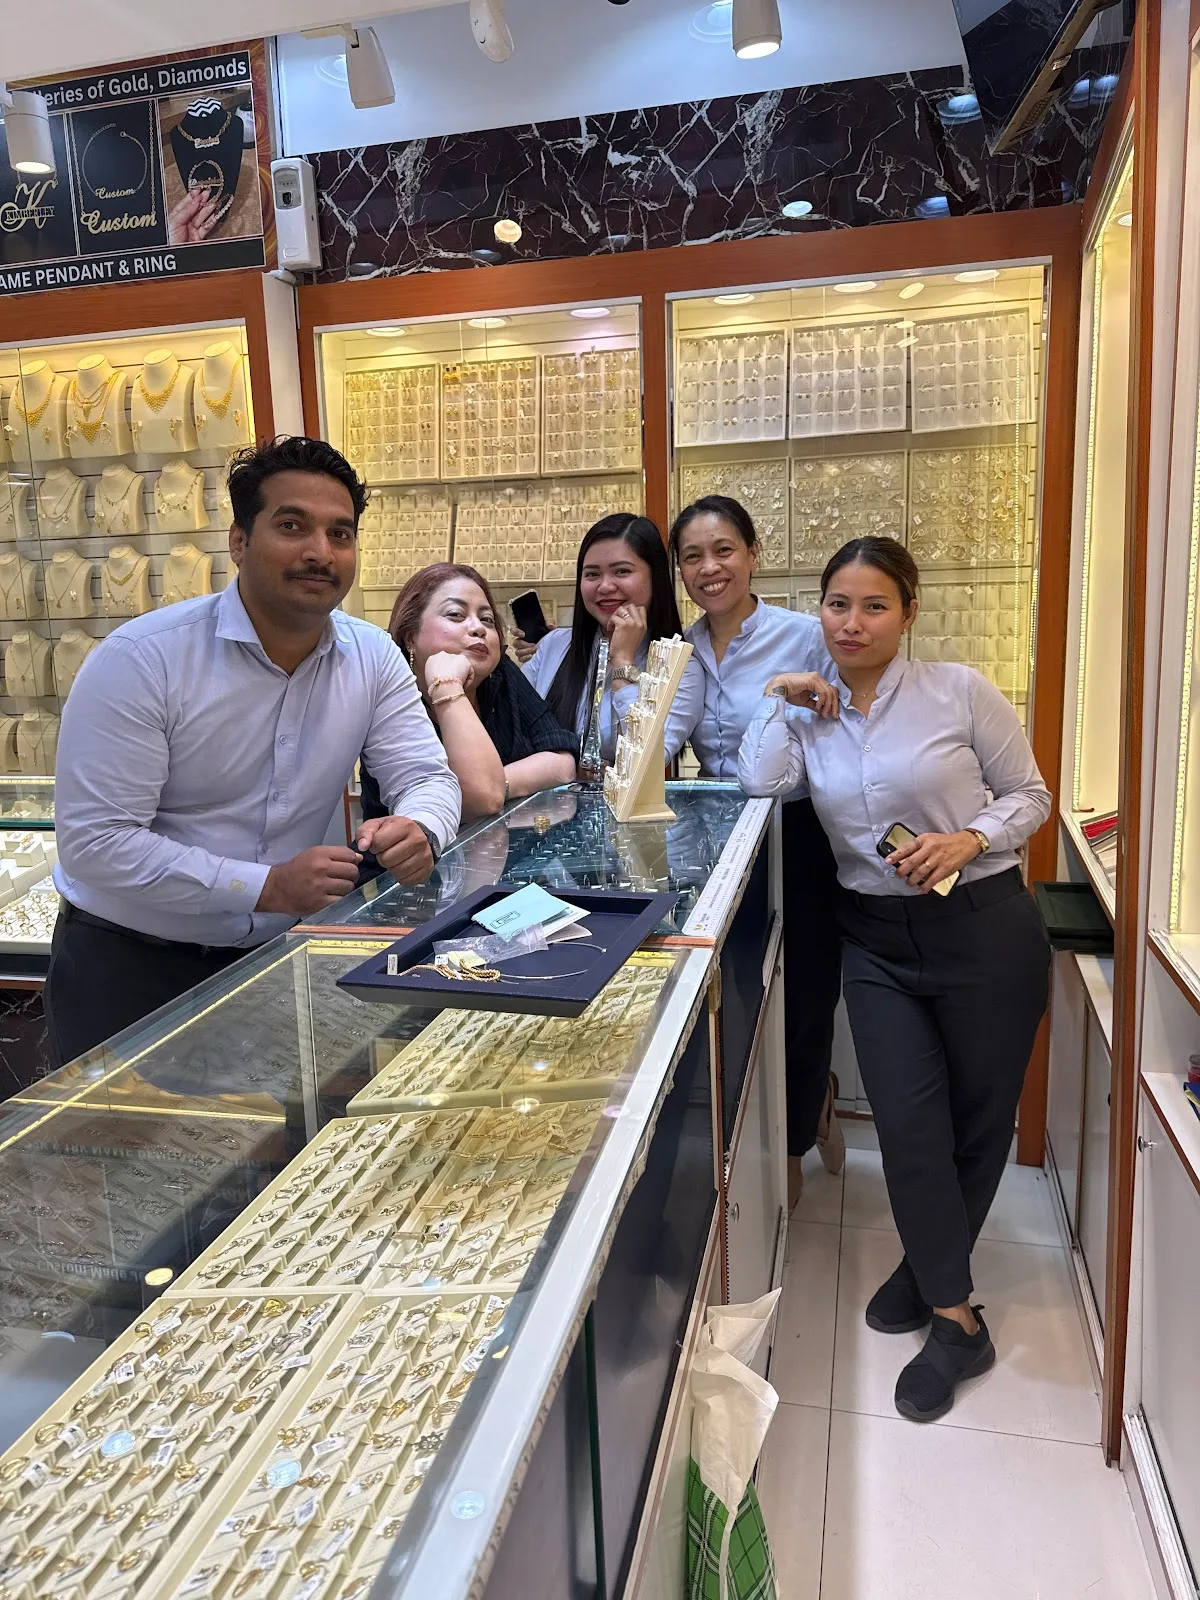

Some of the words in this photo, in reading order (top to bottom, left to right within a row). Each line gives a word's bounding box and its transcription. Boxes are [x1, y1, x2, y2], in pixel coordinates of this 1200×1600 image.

[87, 79, 105, 99] of
[108, 73, 154, 96] Gold,
[158, 58, 247, 88] Diamonds
[95, 187, 137, 199] Custom
[80, 209, 158, 234] Custom
[35, 261, 115, 286] PENDANT
[118, 259, 131, 276] &
[133, 253, 177, 275] RING
